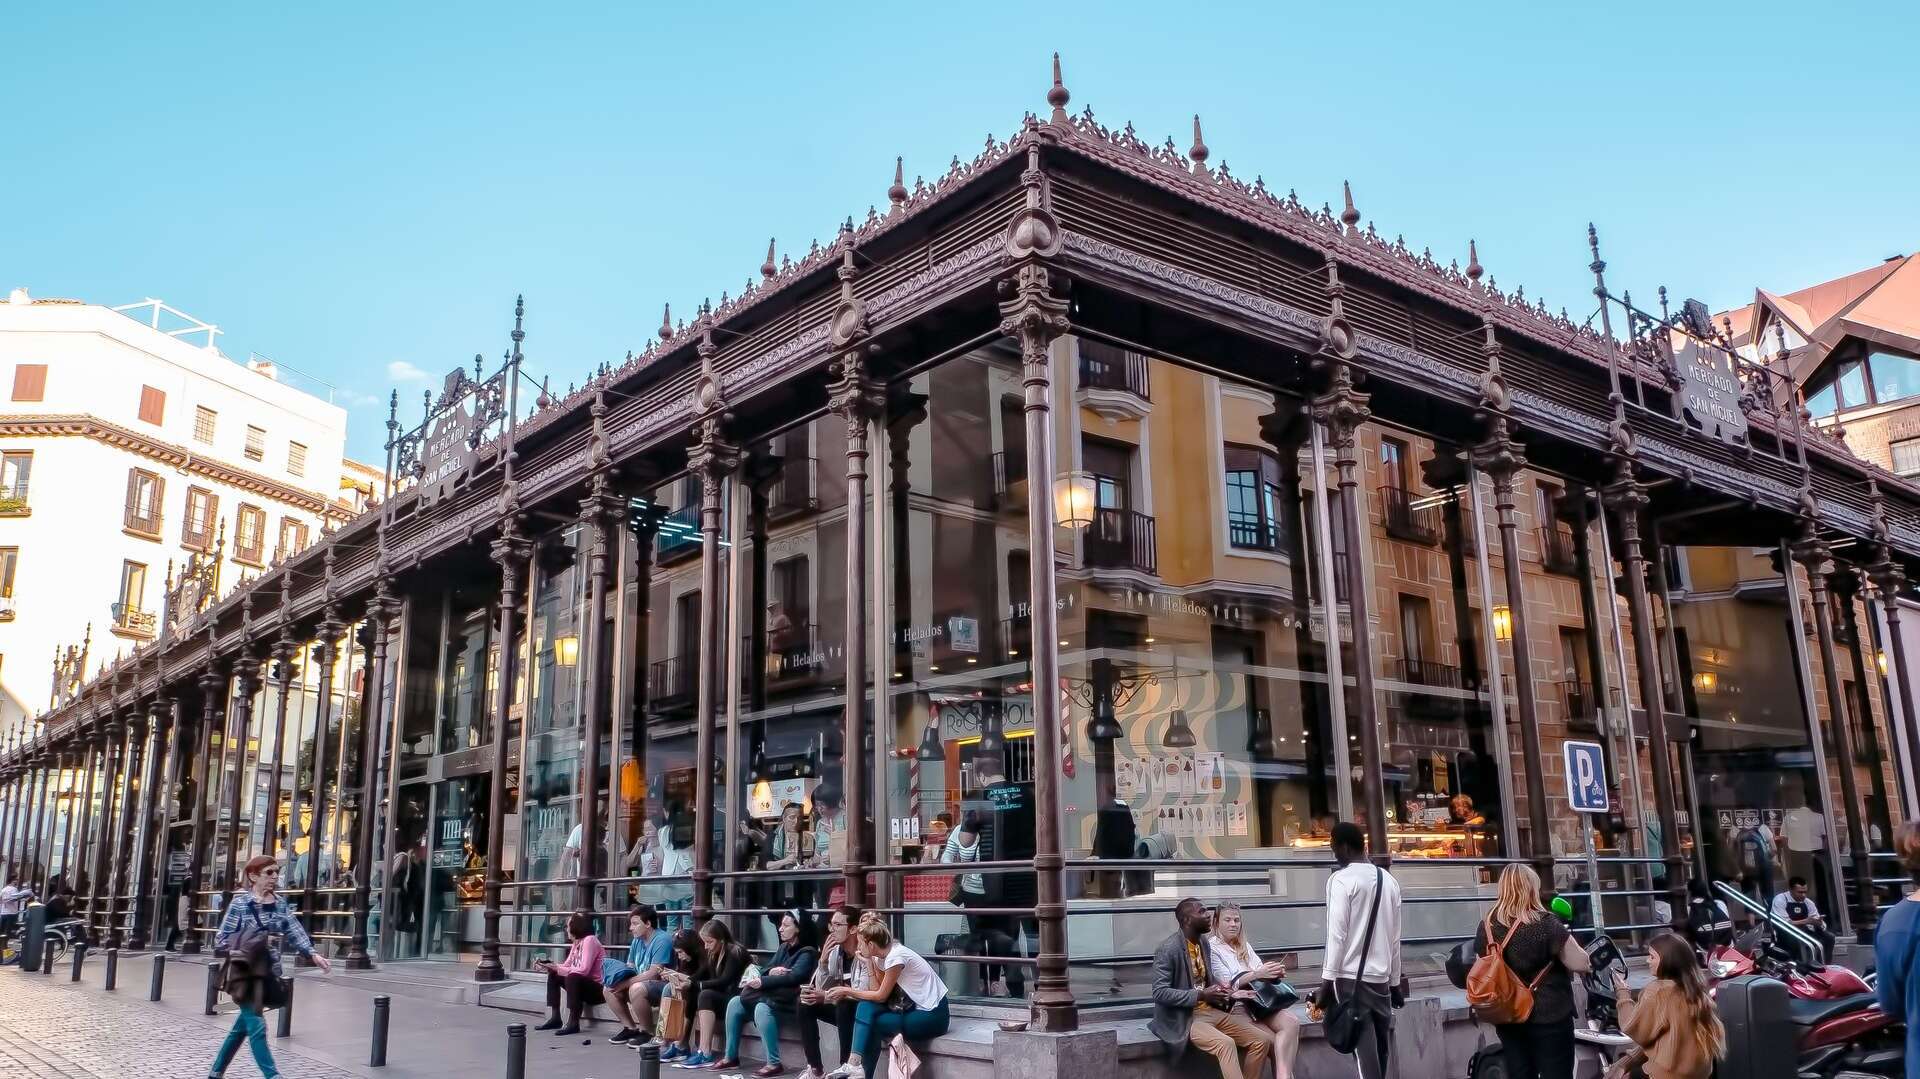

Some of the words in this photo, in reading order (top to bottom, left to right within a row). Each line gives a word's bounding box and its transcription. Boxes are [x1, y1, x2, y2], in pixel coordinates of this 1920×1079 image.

[1688, 365, 1733, 394] MERCADO
[1707, 388, 1720, 401] DE
[1690, 394, 1709, 415] SAN
[1710, 402, 1740, 427] MIGUEL
[430, 425, 465, 458] MERCADO
[440, 449, 450, 462] DE
[424, 469, 438, 488] SAN
[439, 456, 462, 480] MIGUEL
[1162, 595, 1207, 617] Helados
[904, 624, 942, 642] Helados
[793, 652, 825, 667] Helados
[1576, 750, 1593, 806] P
